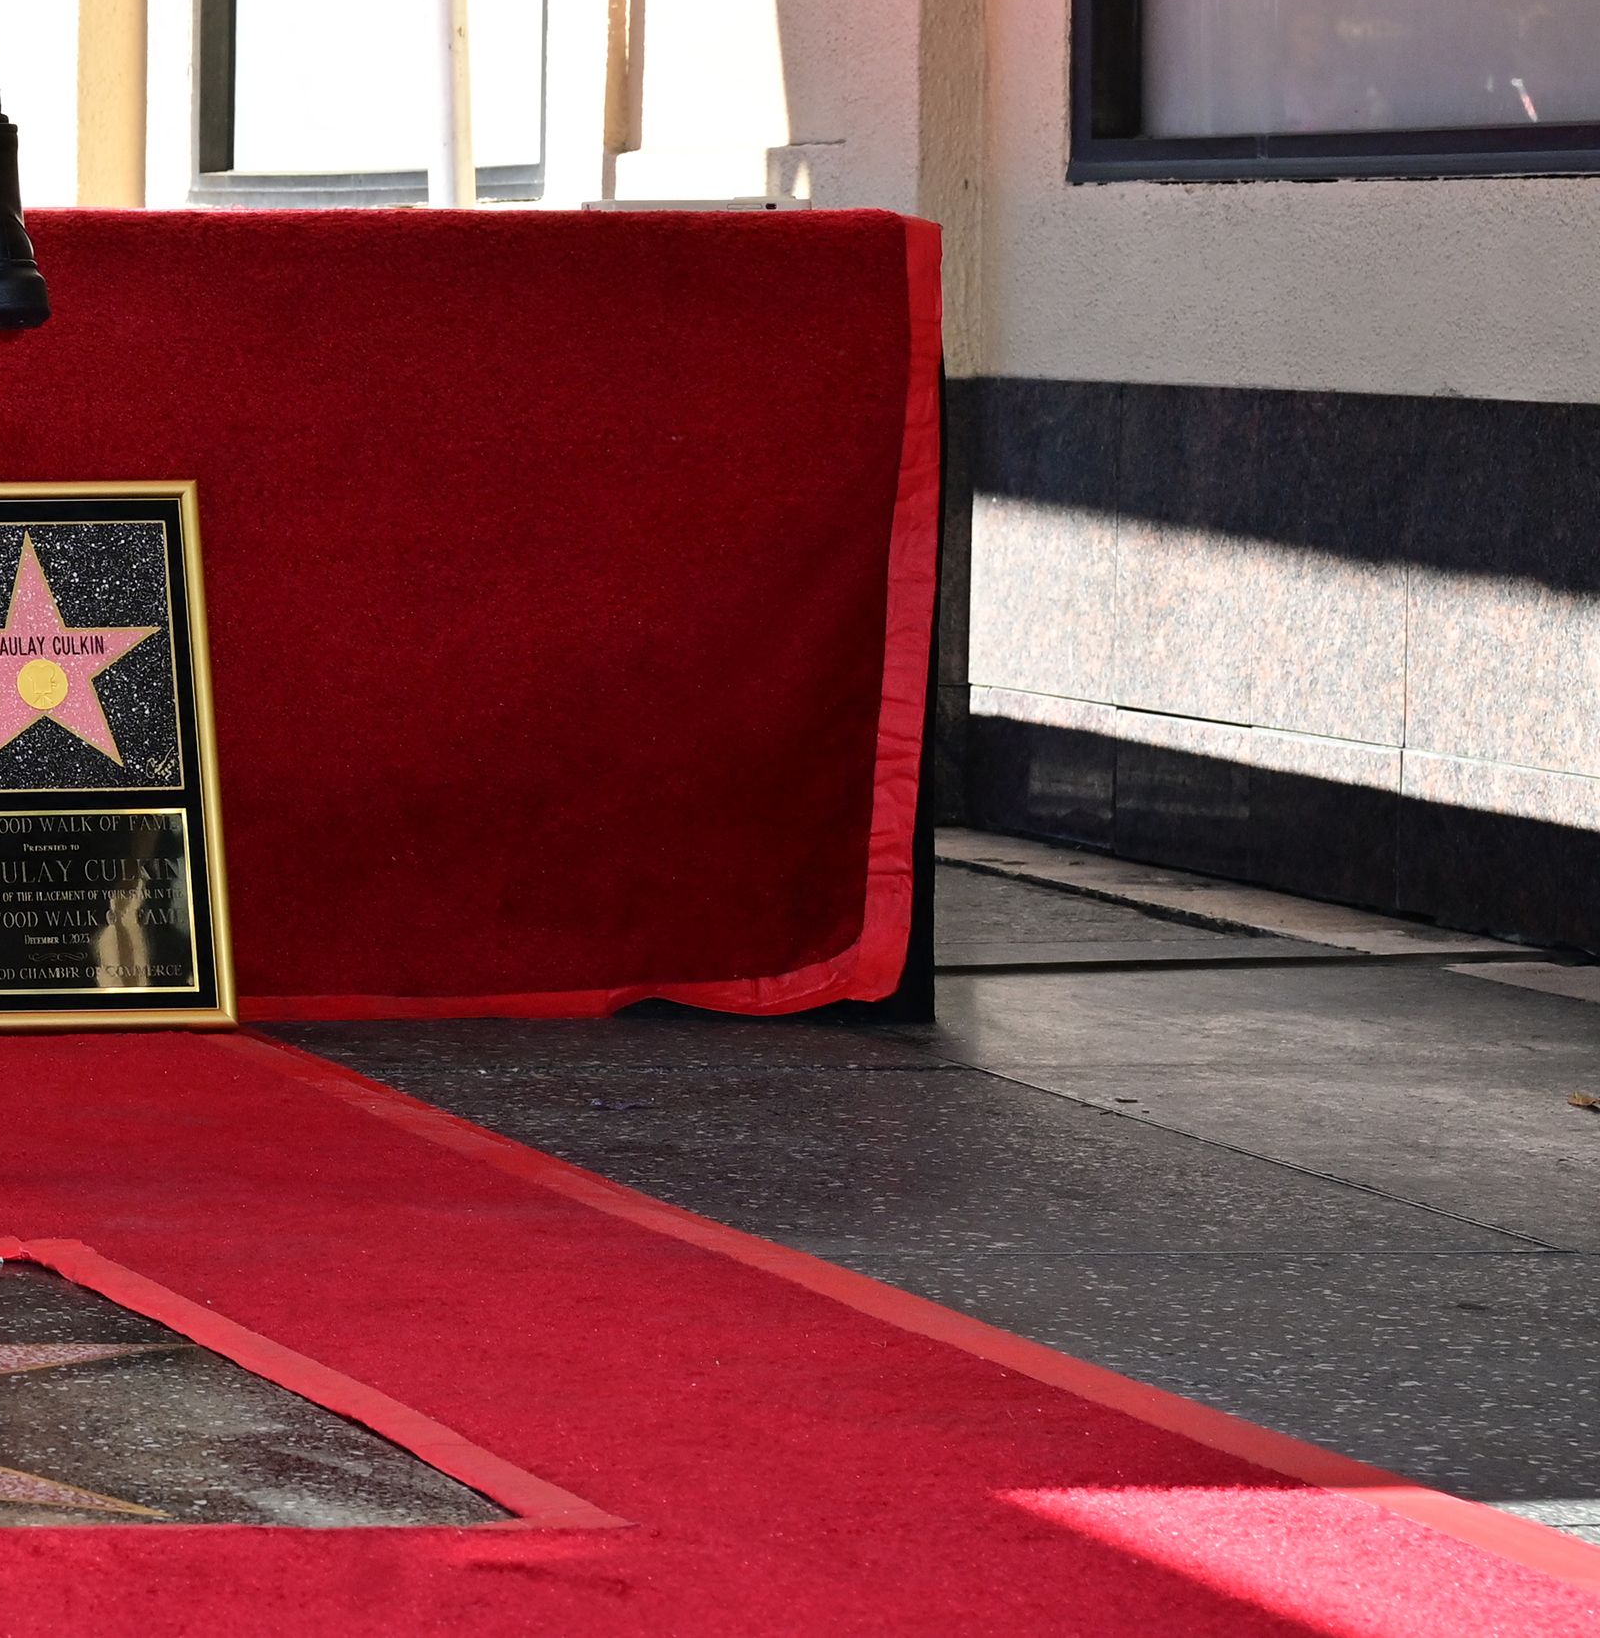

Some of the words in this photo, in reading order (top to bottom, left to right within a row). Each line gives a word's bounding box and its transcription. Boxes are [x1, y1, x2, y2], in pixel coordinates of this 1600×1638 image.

[52, 635, 106, 656] CULKIN
[39, 816, 92, 833] WALK
[99, 815, 120, 832] OF
[84, 857, 183, 882] CULKIN
[3, 892, 14, 903] OF
[87, 890, 99, 901] OF
[45, 910, 98, 927] WALK
[138, 908, 186, 925] AME
[70, 933, 90, 944] 2023
[20, 966, 80, 980] CHAMBER
